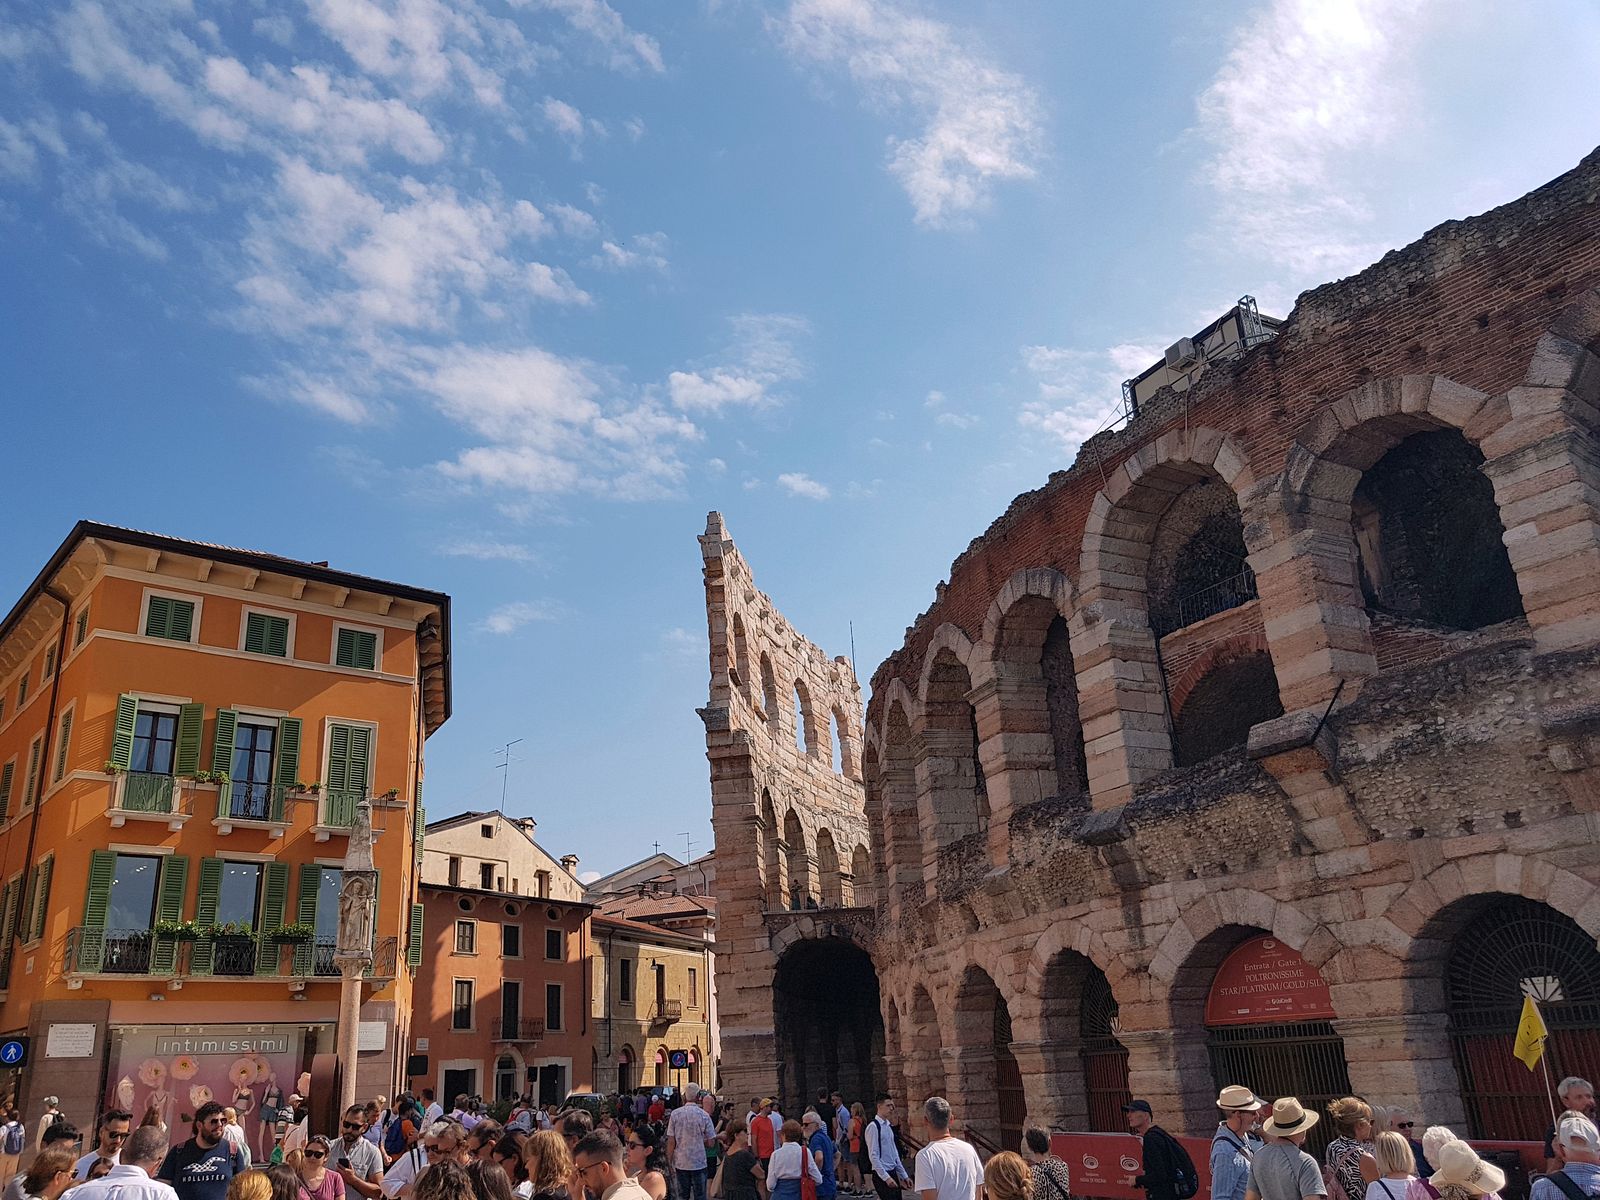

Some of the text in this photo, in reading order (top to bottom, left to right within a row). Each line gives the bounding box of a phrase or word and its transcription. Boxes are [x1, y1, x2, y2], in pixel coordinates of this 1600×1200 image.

[1244, 962, 1270, 971] Entrata
[1277, 959, 1297, 967] Gate
[1245, 969, 1304, 982] POLTRONISSIME
[163, 1039, 283, 1052] intimissimi
[182, 1174, 225, 1182] HOLLISTER
